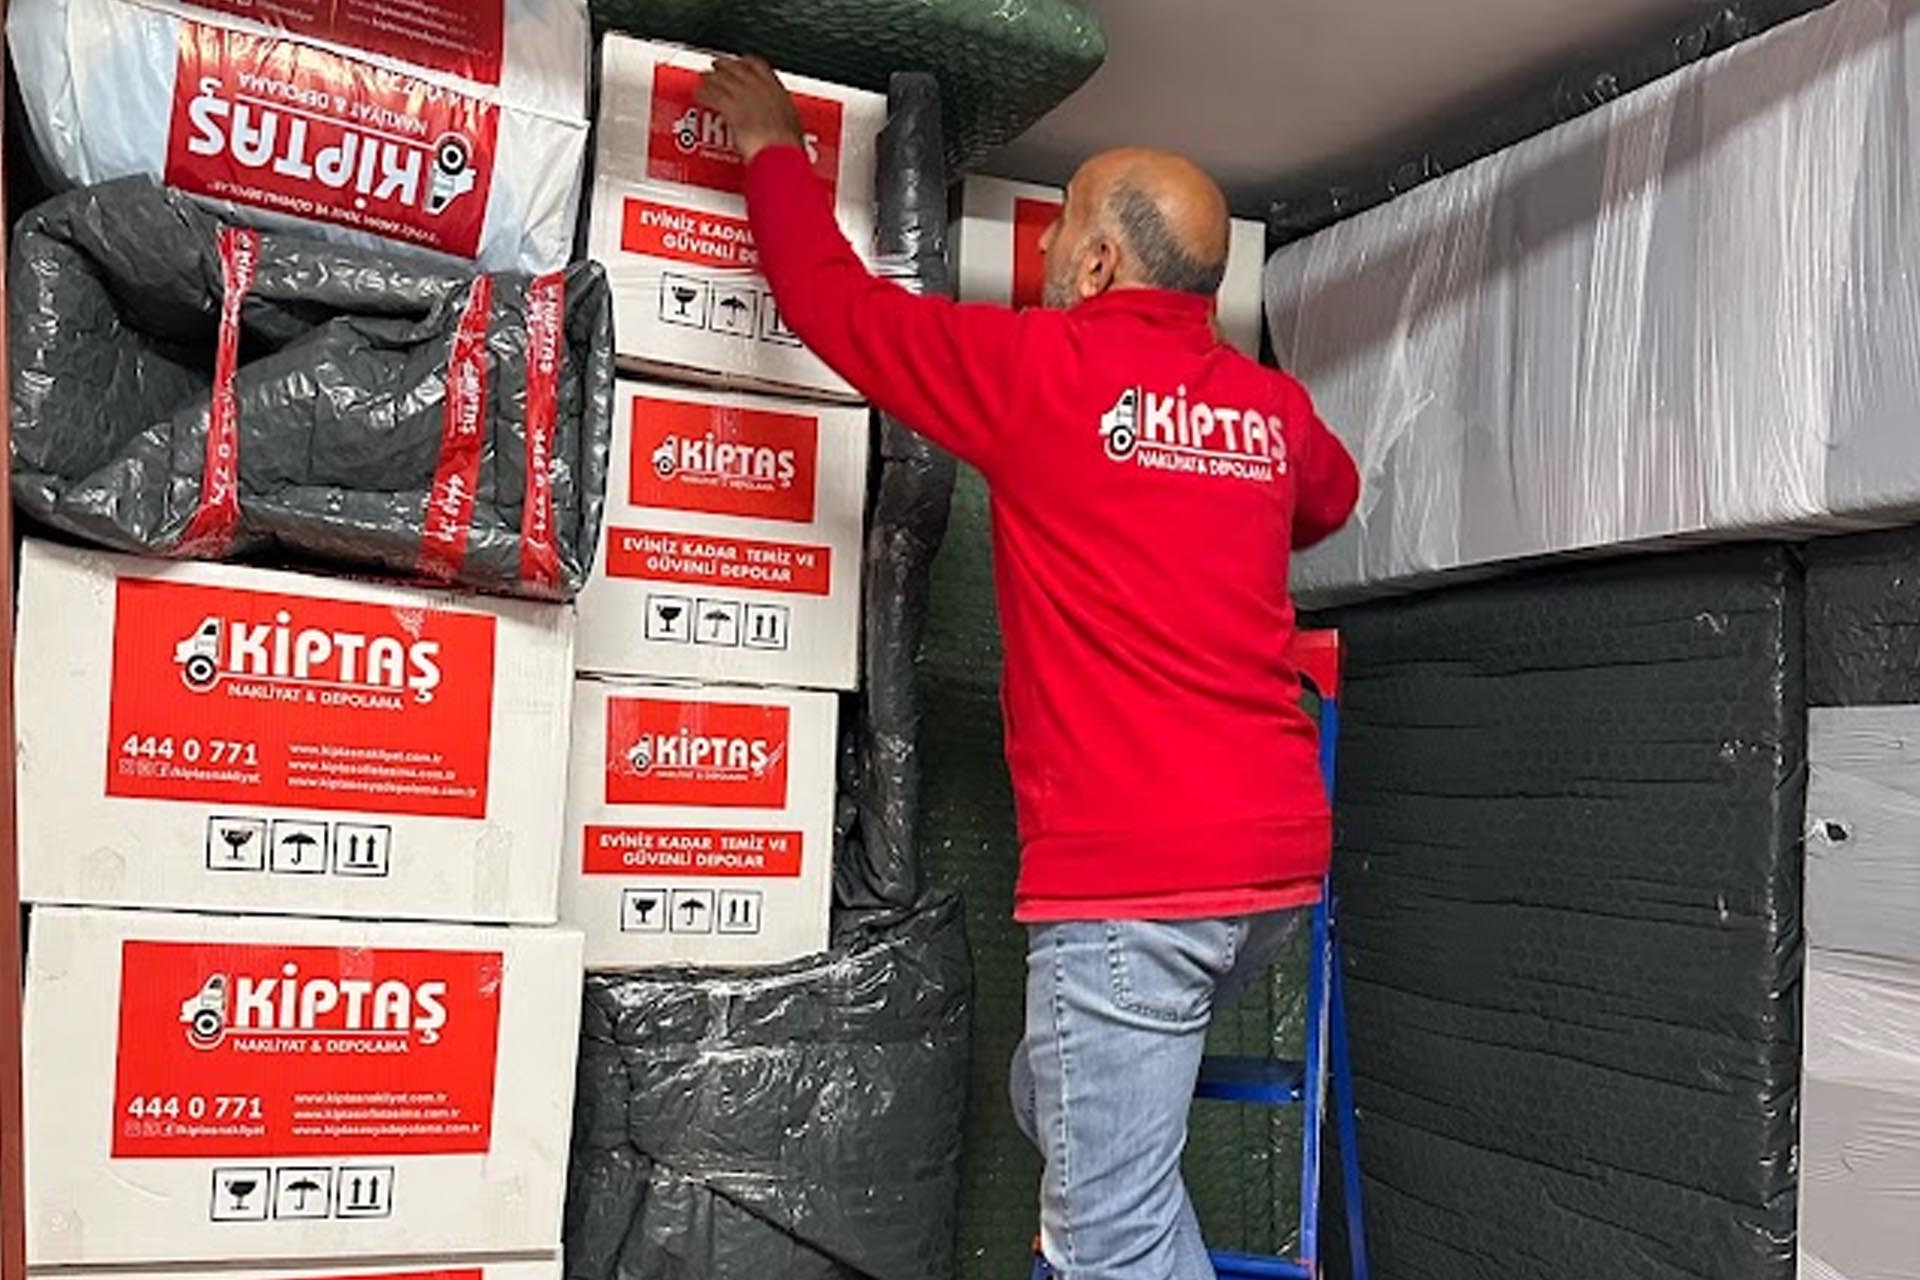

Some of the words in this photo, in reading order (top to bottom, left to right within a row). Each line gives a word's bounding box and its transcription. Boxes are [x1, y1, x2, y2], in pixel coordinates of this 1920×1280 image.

[334, 98, 347, 113] &
[187, 76, 422, 209] KİPTAŞ
[640, 209, 697, 233] EVİNİZ
[662, 231, 735, 259] GÜVENLİ
[1145, 383, 1287, 476] KİPTAŞ
[680, 431, 795, 489] KİPTAŞ
[622, 536, 678, 555] EVİNİZ
[682, 541, 737, 561] KADAR
[746, 547, 791, 567] TEMİZ
[795, 552, 815, 568] VE
[646, 556, 717, 576] GÜVENLİ
[720, 562, 792, 583] DEPOLAR
[229, 609, 441, 703] KİPTAŞ
[305, 690, 316, 703] &
[321, 690, 403, 711] DEPOLAMA
[122, 734, 174, 760] 444
[183, 738, 201, 763] 0
[209, 739, 257, 766] 771
[656, 727, 768, 777] KİPTAŞ
[601, 832, 654, 849] EVİNİZ
[659, 834, 712, 850] KADAR
[720, 835, 765, 851] TEMİZ
[768, 838, 788, 852] VE
[622, 850, 692, 867] GÜVENLİ
[696, 853, 764, 868] DEPOLAR
[234, 962, 446, 1046] KİPTAŞ
[310, 1039, 322, 1053] &
[327, 1039, 408, 1054] DEPOLAMA
[128, 1096, 180, 1119] 444
[188, 1096, 206, 1119] 0
[215, 1096, 263, 1119] 771
